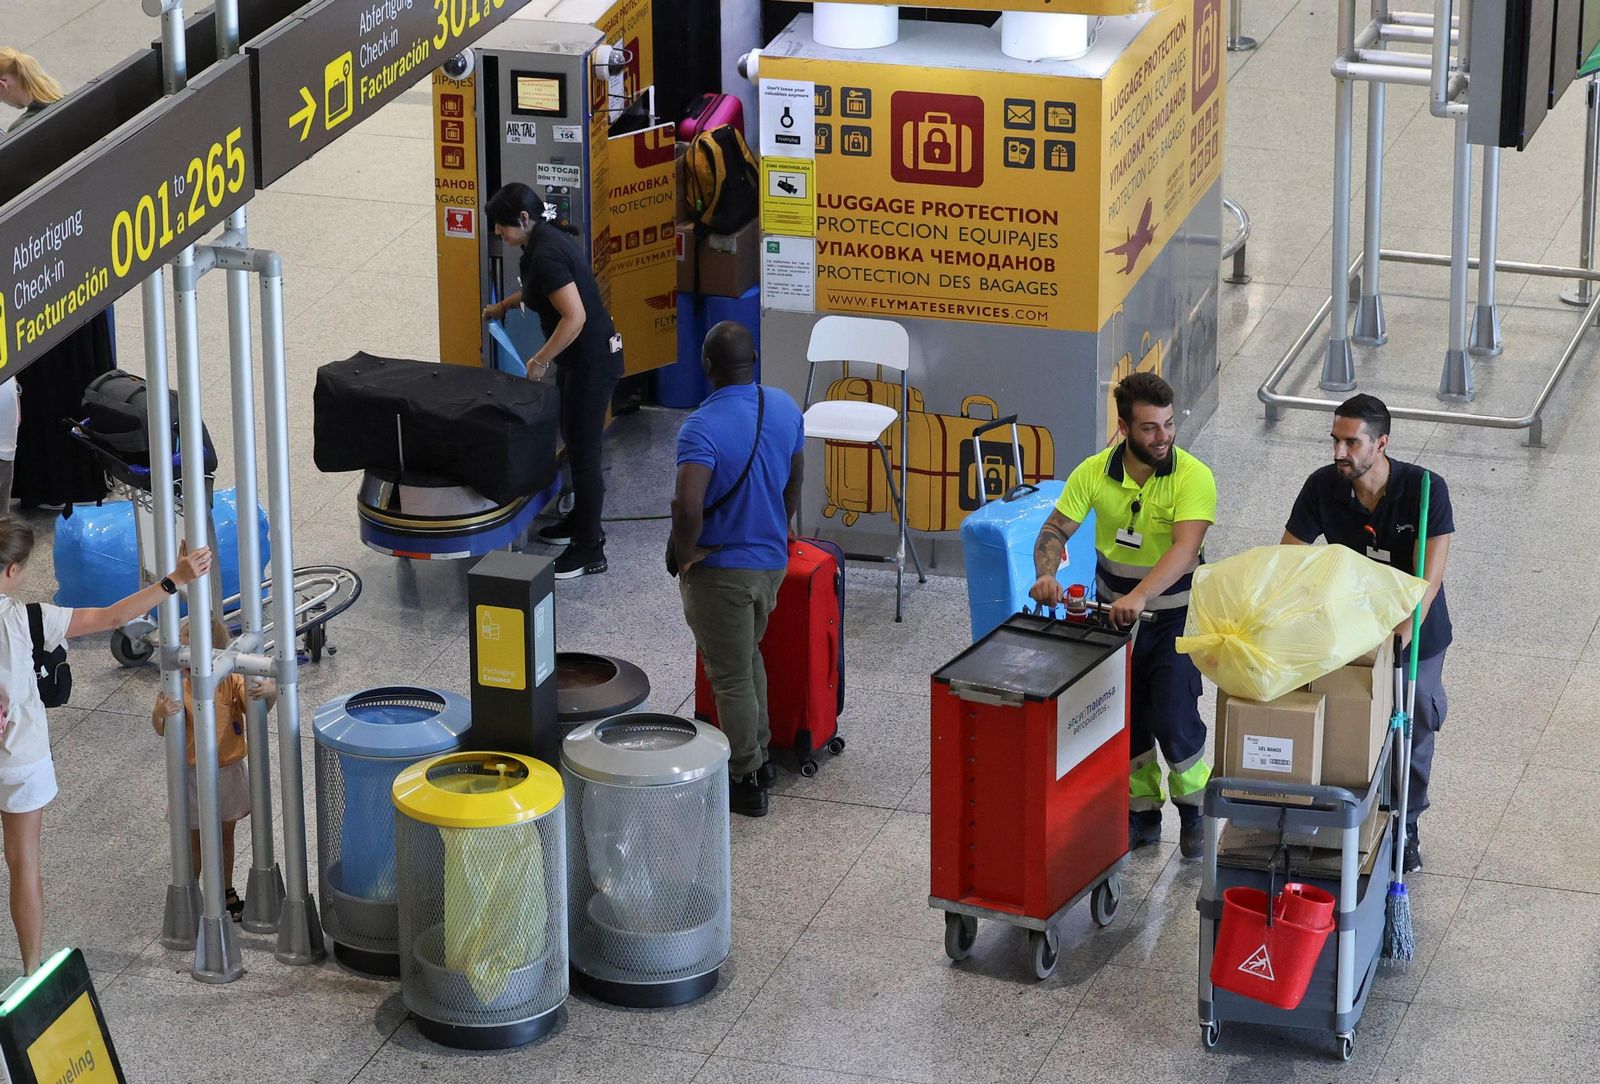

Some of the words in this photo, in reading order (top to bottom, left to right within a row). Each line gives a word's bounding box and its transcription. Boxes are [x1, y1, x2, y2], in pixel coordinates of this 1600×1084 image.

[359, 25, 399, 68] Check-in
[360, 38, 430, 105] Facturación
[1110, 67, 1143, 122] LUGGAGE
[1143, 15, 1187, 82] PROTECTION
[1109, 92, 1152, 156] PROTECCION
[1154, 48, 1187, 102] EQUIPAJES
[507, 122, 520, 137] AIR
[1109, 132, 1146, 190] УПАКОВКА
[1146, 81, 1187, 142] ЧЕМОДАНОВ
[174, 174, 185, 197] to
[552, 167, 579, 175] TOCAR
[1108, 166, 1146, 224] PROTECTION
[1160, 114, 1187, 162] BAGAGES
[817, 193, 915, 215] LUGGAGE
[921, 200, 1058, 226] PROTECTION
[13, 209, 83, 275] Abfertigung
[16, 267, 109, 351] Facturación
[111, 180, 174, 278] 001
[177, 212, 185, 234] a
[186, 126, 245, 227] 265
[817, 216, 948, 241] PROTECCION
[959, 227, 1058, 251] EQUIPAJES
[817, 240, 924, 263] УПАКОВКА
[931, 249, 1056, 273] ЧЕМОДАНОВ
[14, 257, 66, 310] Check-in
[817, 265, 930, 287] PROTECTION
[939, 274, 971, 290] DES
[979, 278, 1058, 297] BAGAGES
[828, 293, 1048, 322] WWW.FLYMATESERVICES.COM
[56, 1049, 95, 1084] ueling
